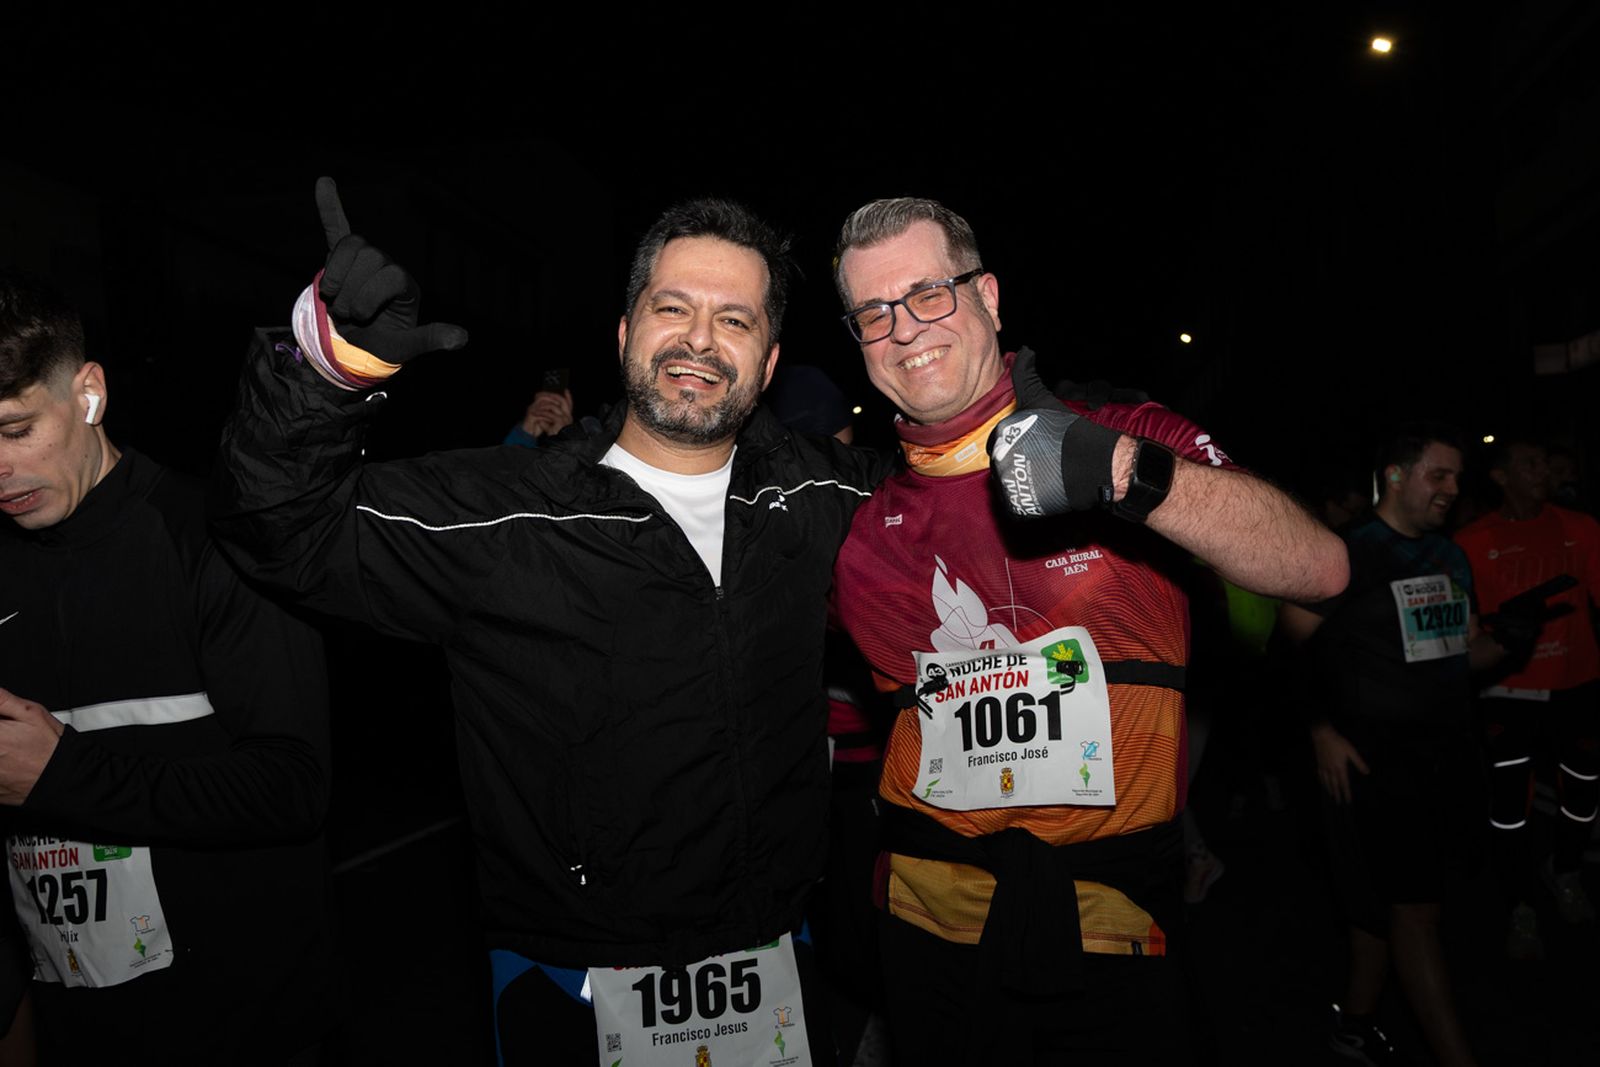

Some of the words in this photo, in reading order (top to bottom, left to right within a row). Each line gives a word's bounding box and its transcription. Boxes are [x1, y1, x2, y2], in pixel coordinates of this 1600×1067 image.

[1005, 426, 1021, 445] 43
[1004, 479, 1027, 516] SAN
[1011, 453, 1041, 516] ANTÓN
[1069, 549, 1103, 563] RURAL
[949, 655, 1002, 677] NOCHE
[1006, 654, 1027, 667] DE
[935, 680, 965, 704] SAN
[970, 667, 1029, 696] ANTÓN
[954, 691, 1062, 752] 1061
[968, 750, 1017, 768] Francisco
[1021, 746, 1049, 760] José
[32, 844, 79, 870] ANTÓN
[27, 868, 108, 926] 1257
[632, 957, 762, 1028] 1965
[652, 1028, 711, 1046] Francisco
[714, 1021, 748, 1039] Jesus
